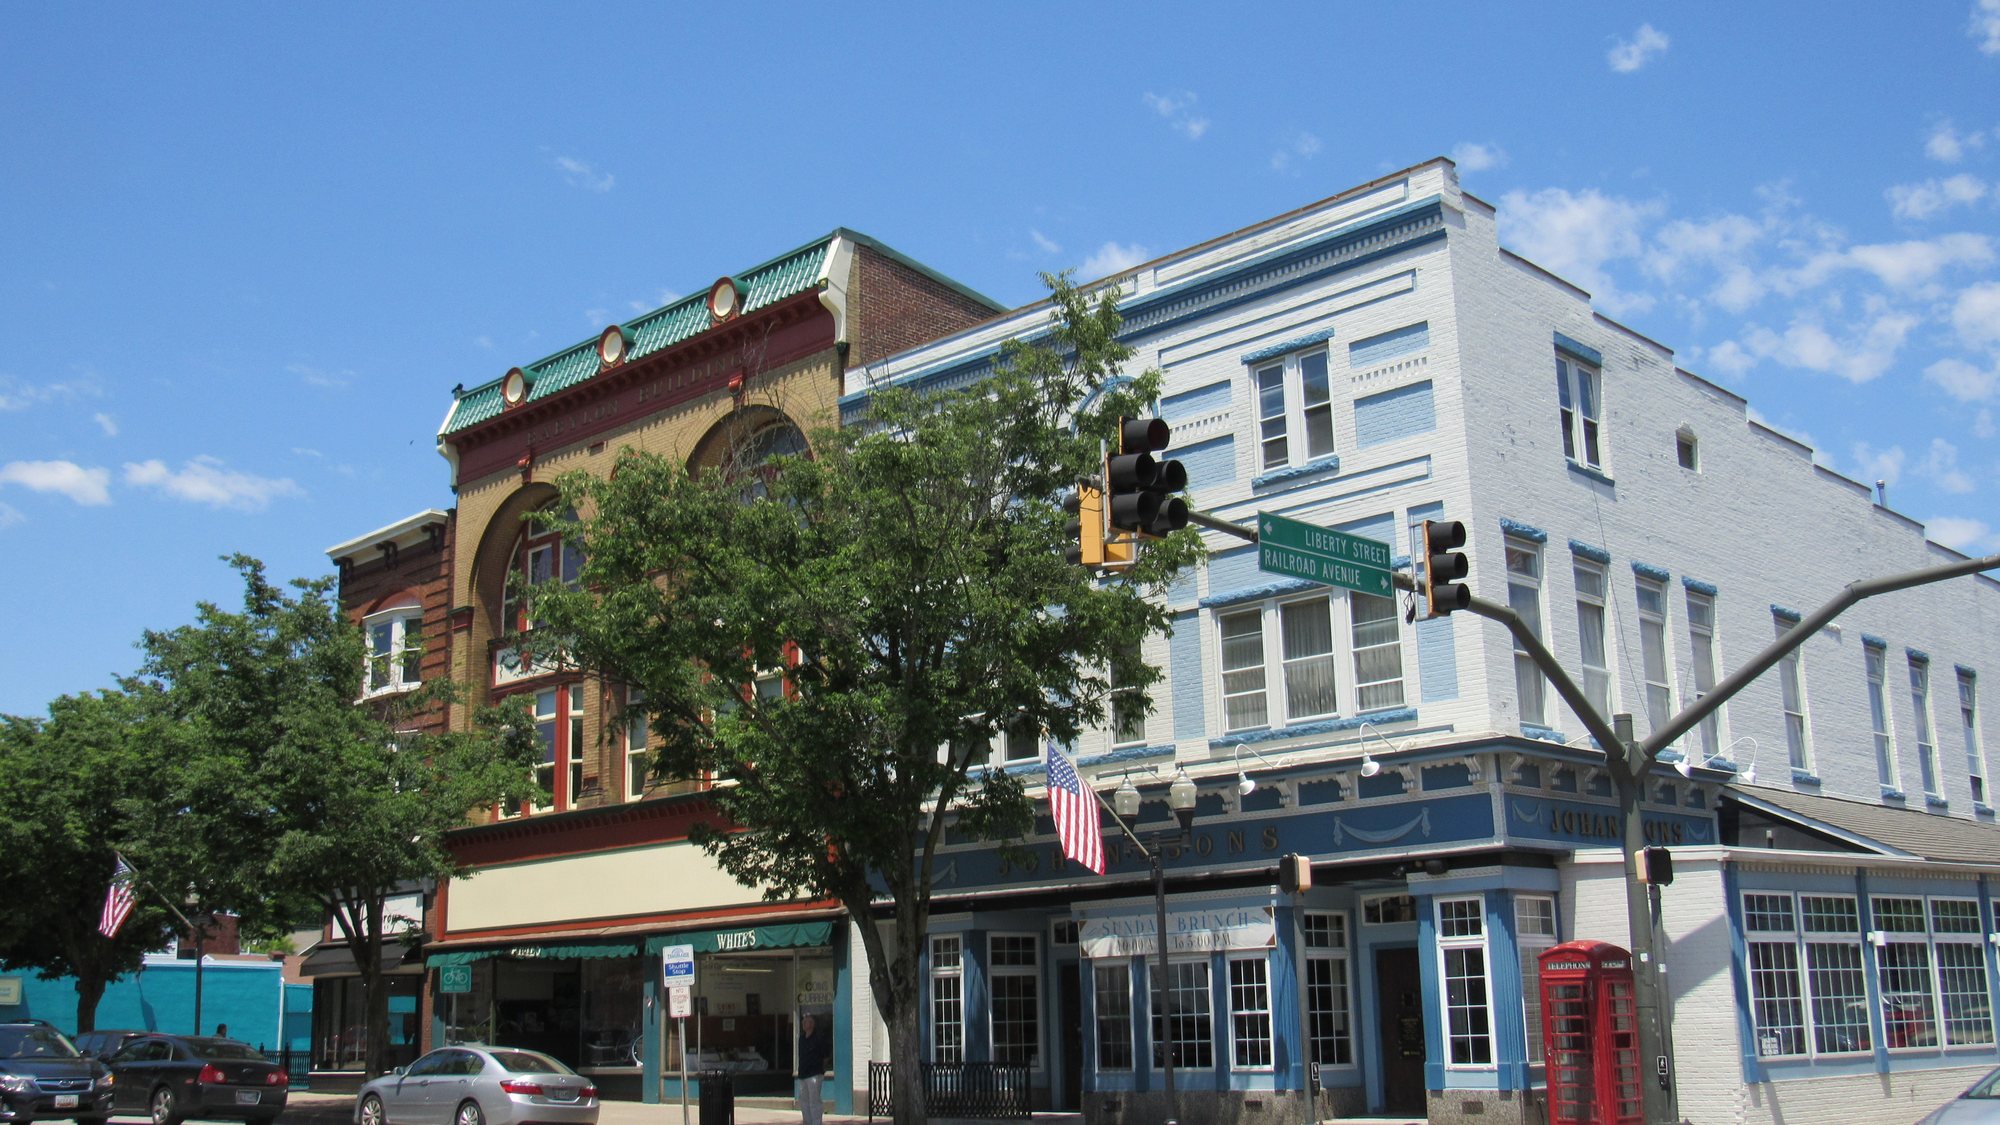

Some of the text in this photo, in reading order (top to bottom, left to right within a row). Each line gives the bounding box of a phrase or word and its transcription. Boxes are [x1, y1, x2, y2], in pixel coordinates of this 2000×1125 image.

[639, 355, 742, 402] BUILDING
[1305, 530, 1386, 564] LIBERTY STREET
[1264, 549, 1361, 586] RAILROAD AVENUE
[1551, 809, 1682, 841] JOHANONS
[1000, 826, 1279, 875] JOHNSONS
[717, 929, 756, 949] WHITE'S
[1102, 912, 1248, 935] SUNDA BRUNCH
